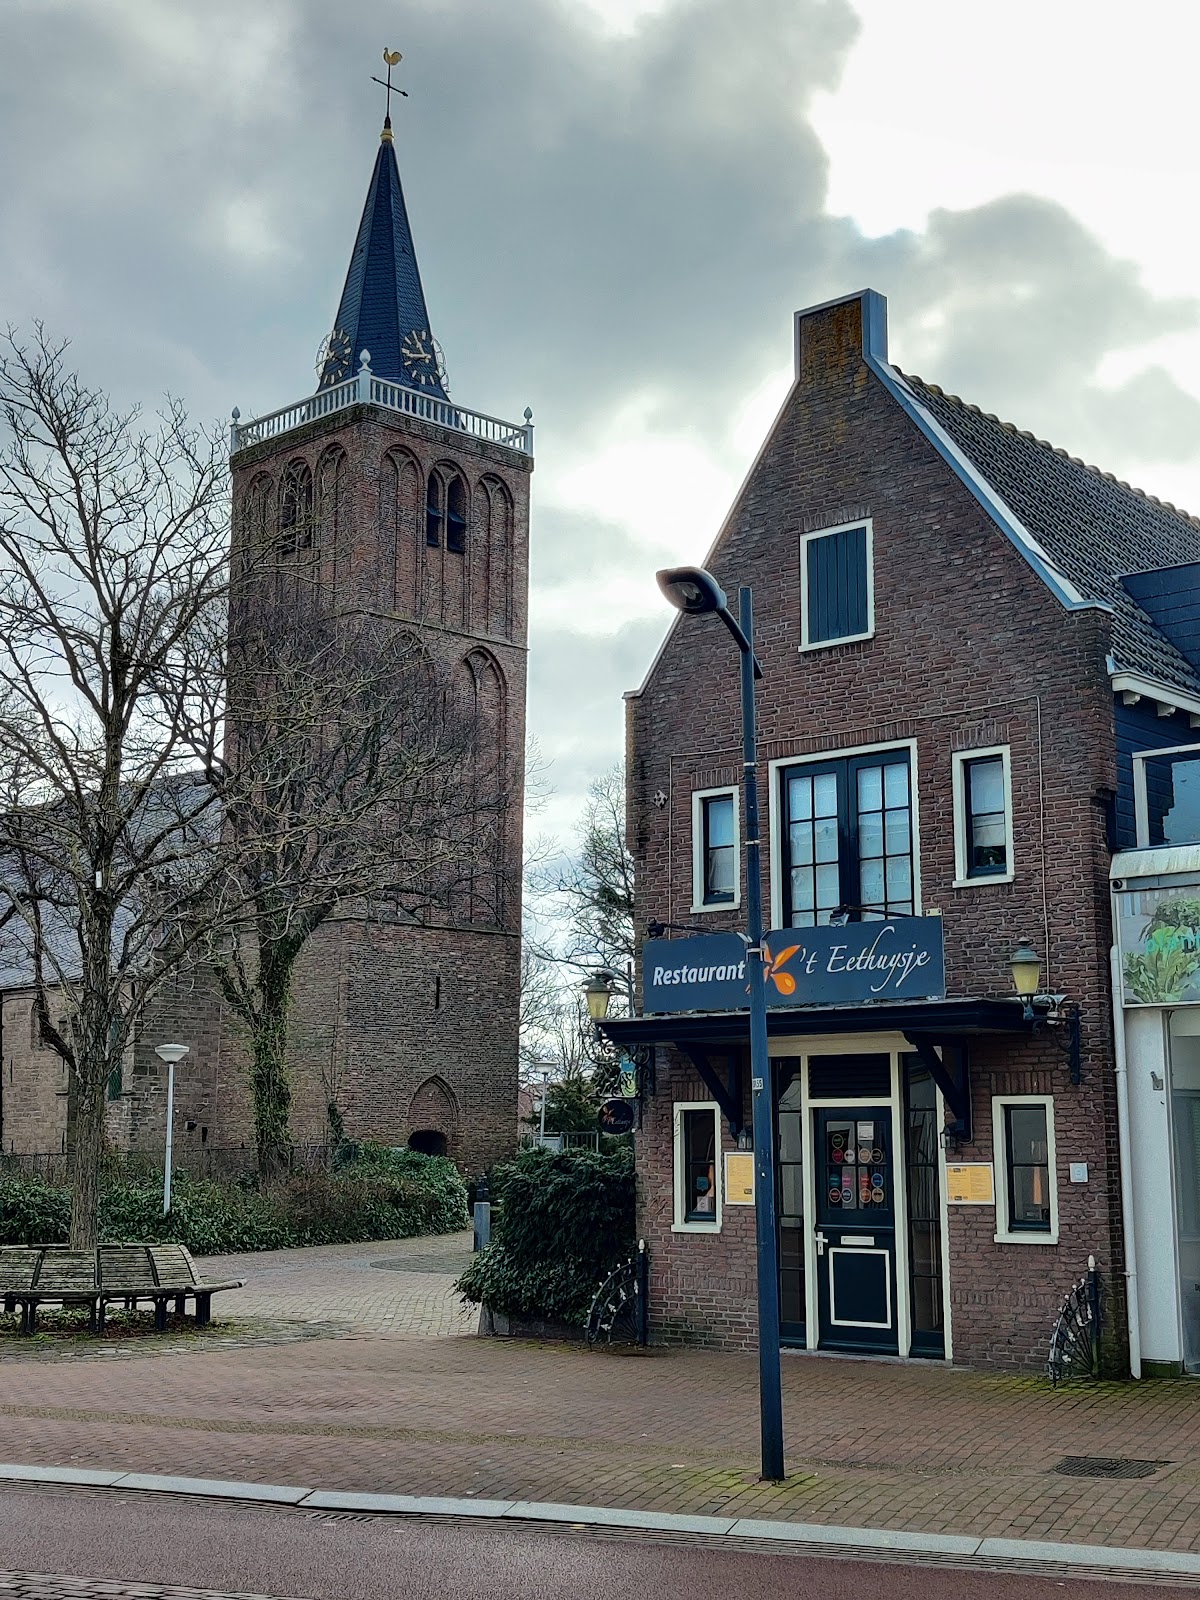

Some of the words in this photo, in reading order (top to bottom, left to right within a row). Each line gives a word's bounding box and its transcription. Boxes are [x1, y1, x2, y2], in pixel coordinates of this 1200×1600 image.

[653, 960, 746, 986] Restaurant
[800, 948, 818, 974] 't
[826, 925, 931, 992] Eethuysje
